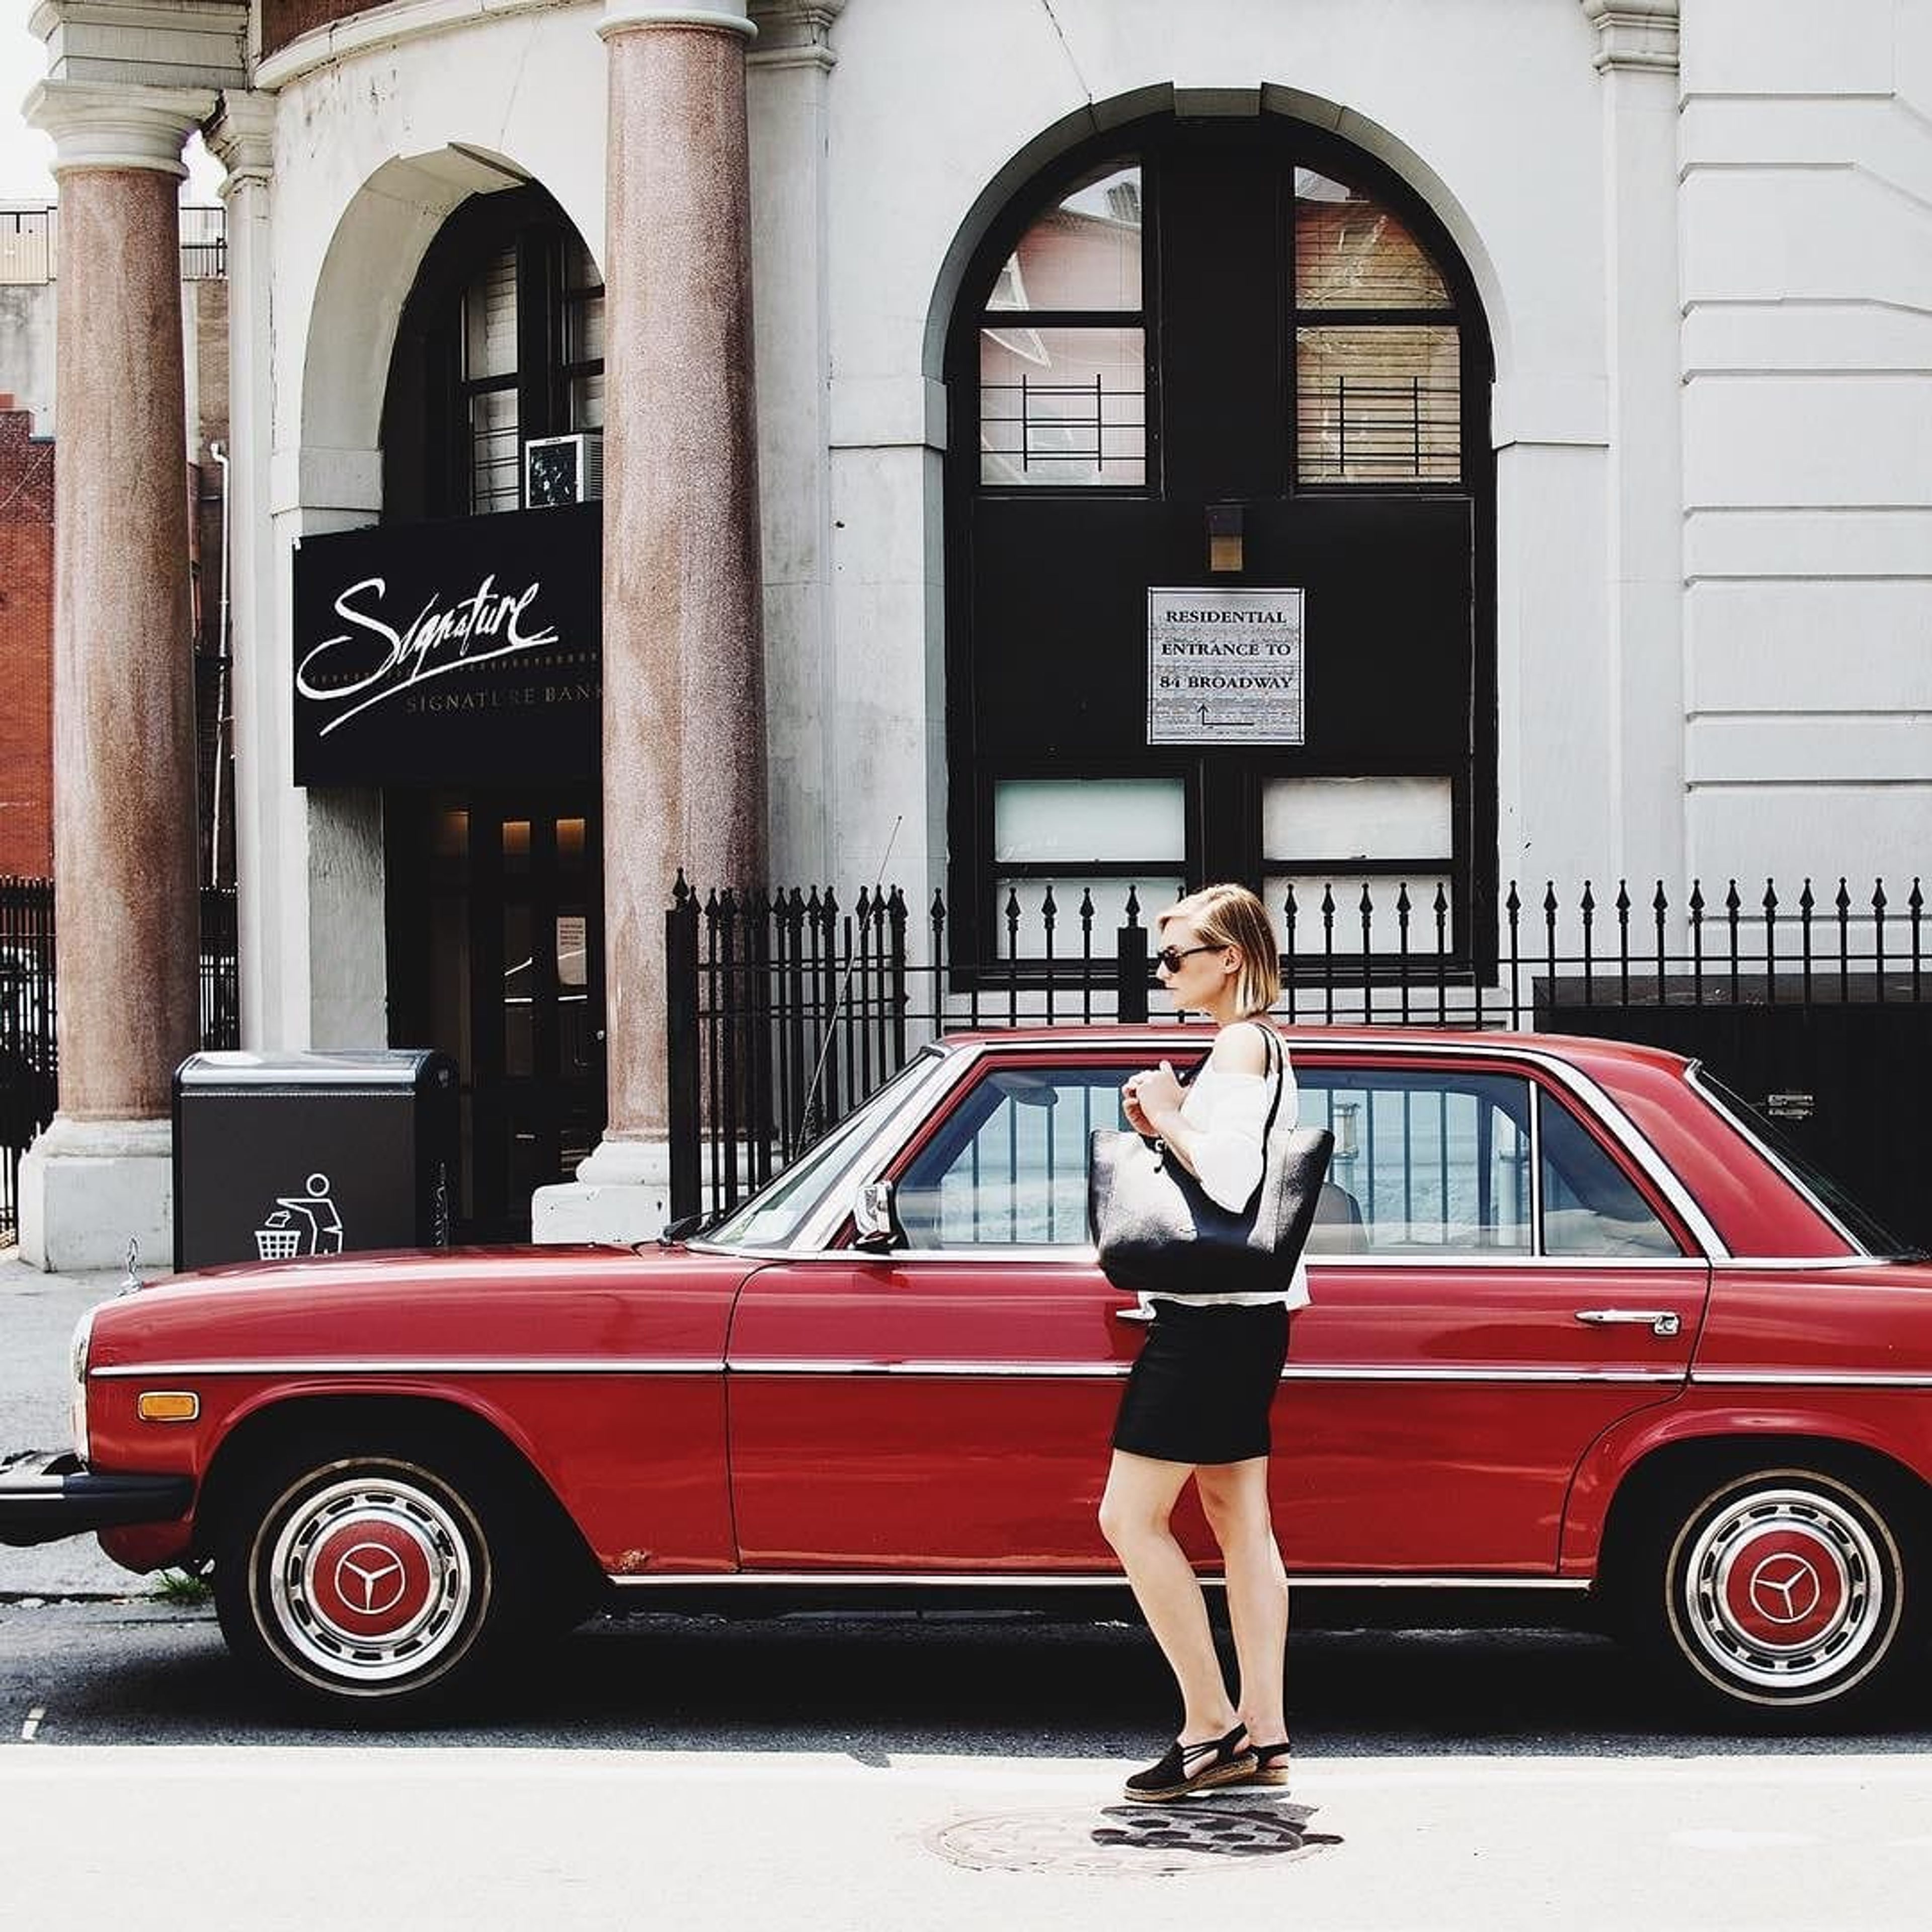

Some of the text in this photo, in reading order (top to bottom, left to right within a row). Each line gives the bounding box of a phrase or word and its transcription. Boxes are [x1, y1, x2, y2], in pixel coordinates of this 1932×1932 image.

[1165, 610, 1287, 623] RESIDENTIAL
[297, 574, 558, 703] Signature
[1161, 643, 1292, 656] ENTRANCE TO
[1159, 675, 1293, 689] 84 BROADWAY
